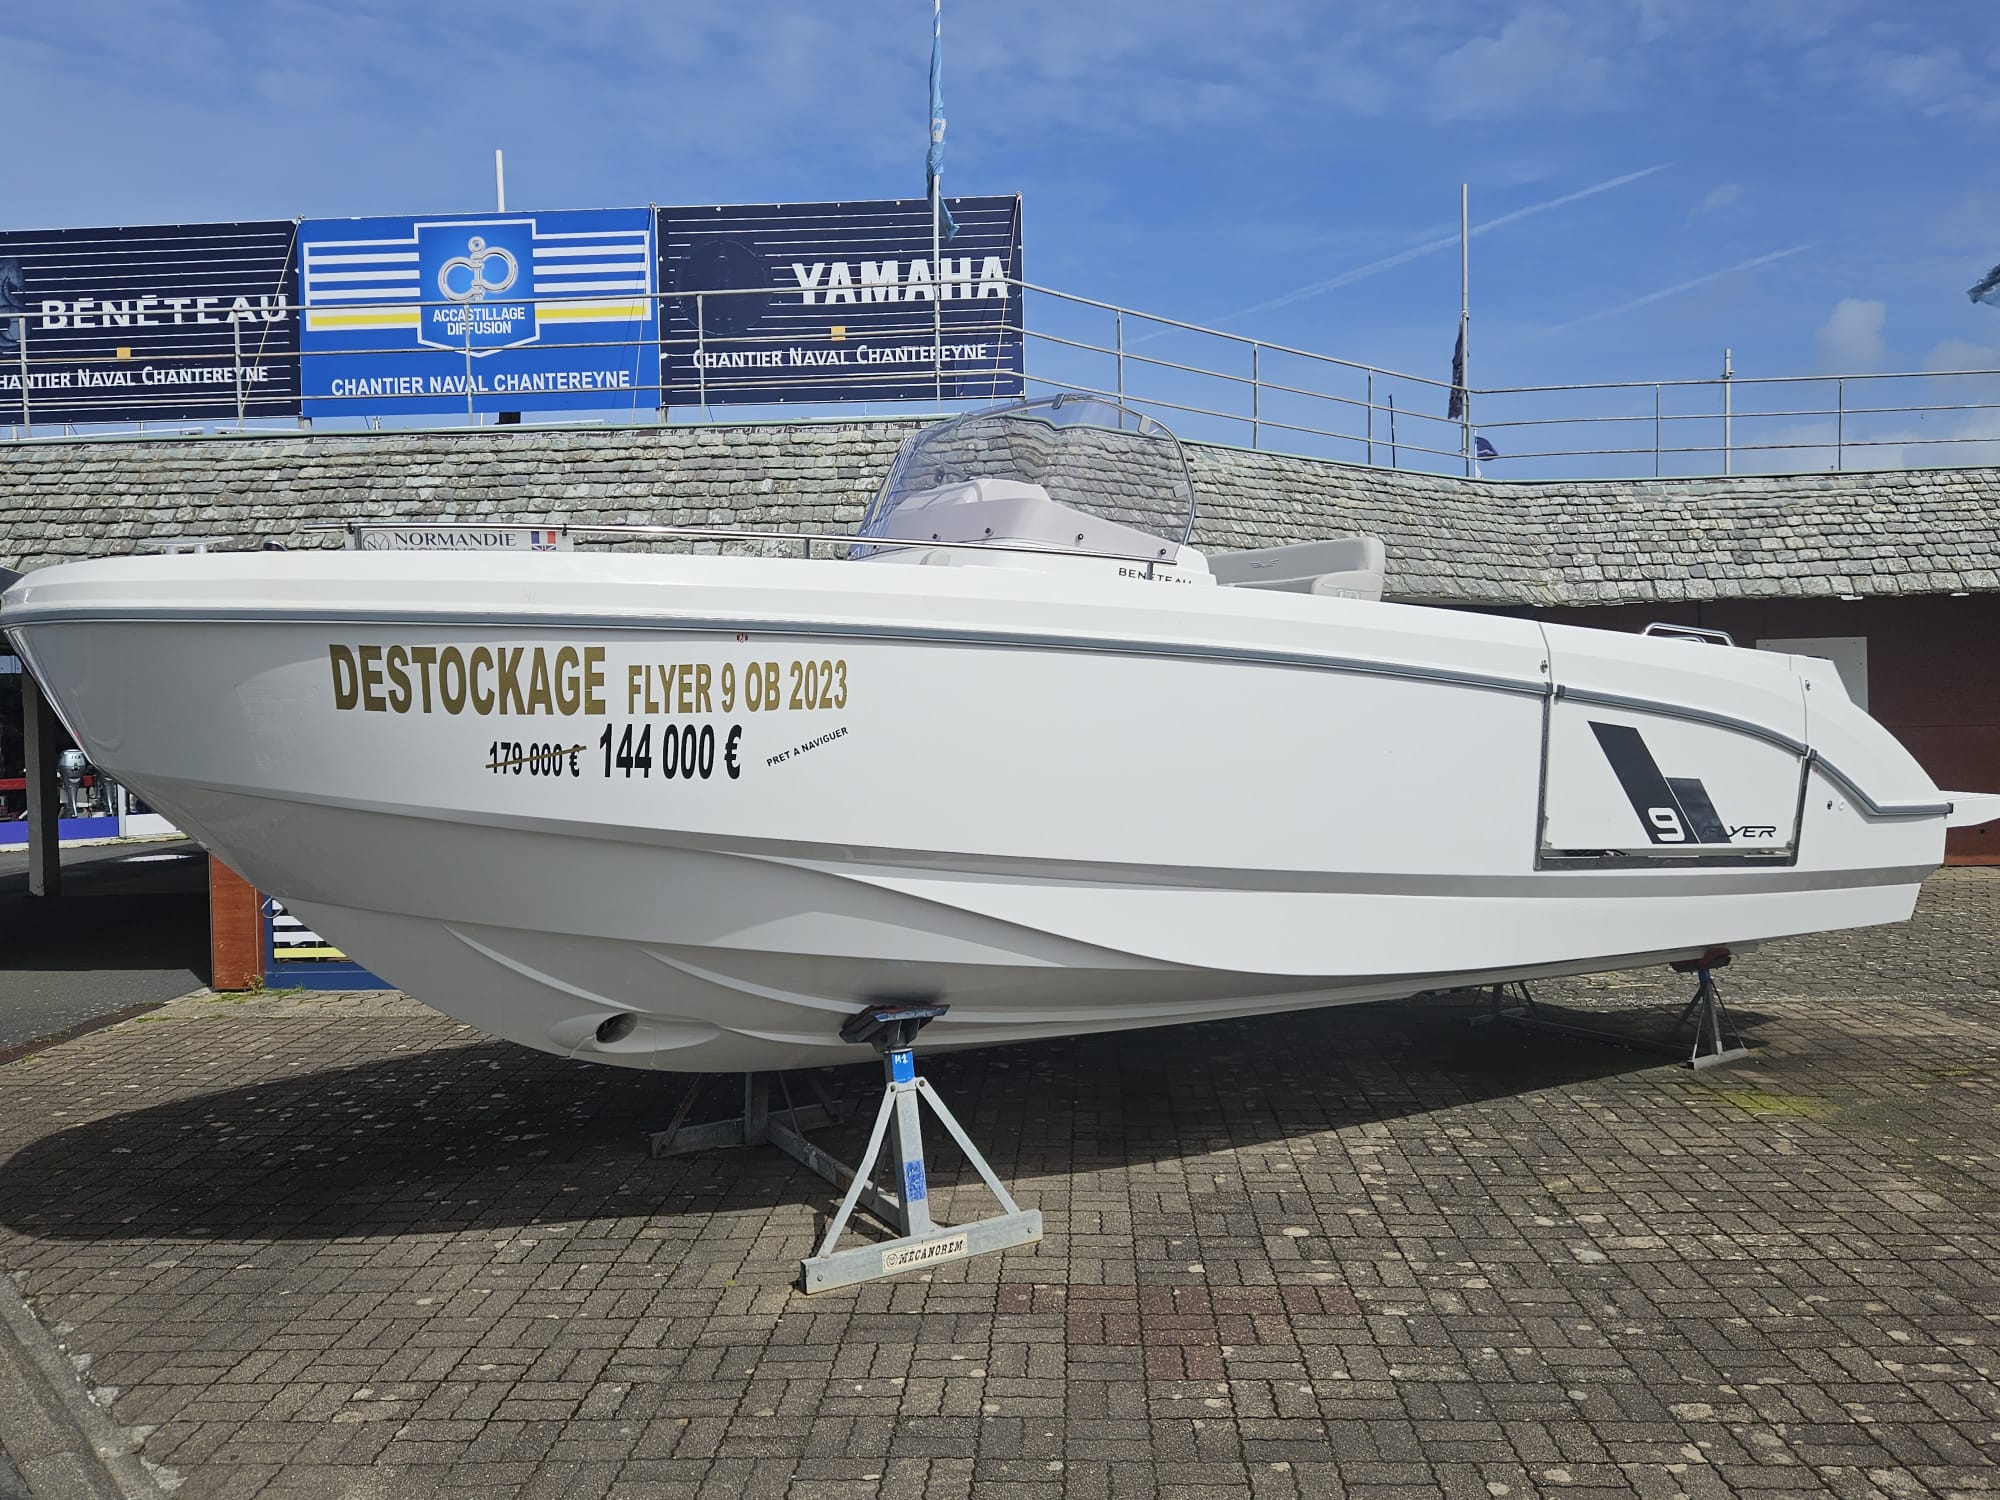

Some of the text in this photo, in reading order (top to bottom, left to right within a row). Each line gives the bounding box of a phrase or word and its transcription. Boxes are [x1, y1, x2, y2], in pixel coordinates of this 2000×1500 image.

[791, 256, 1009, 304] YAMAHA
[433, 307, 526, 323] ACCASTILLAGE
[447, 321, 512, 336] DIFFUSION
[692, 349, 783, 368] CHANTIER
[789, 347, 849, 366] NAVAL
[0, 366, 268, 390] HANTIER NAVAL CHANTEREYNE
[331, 370, 631, 396] CHANTIER NAVAL CHANTEREYNE
[329, 644, 848, 716] DESTOCKAGE FLYER 9 OB 2023
[490, 741, 523, 776] 179
[529, 742, 563, 777] 000
[600, 723, 743, 780] 144 000 €
[766, 727, 849, 767] PRET A NAVIGUER
[1648, 807, 1777, 842] 9 FYER
[898, 1240, 964, 1265] MECANOREM
